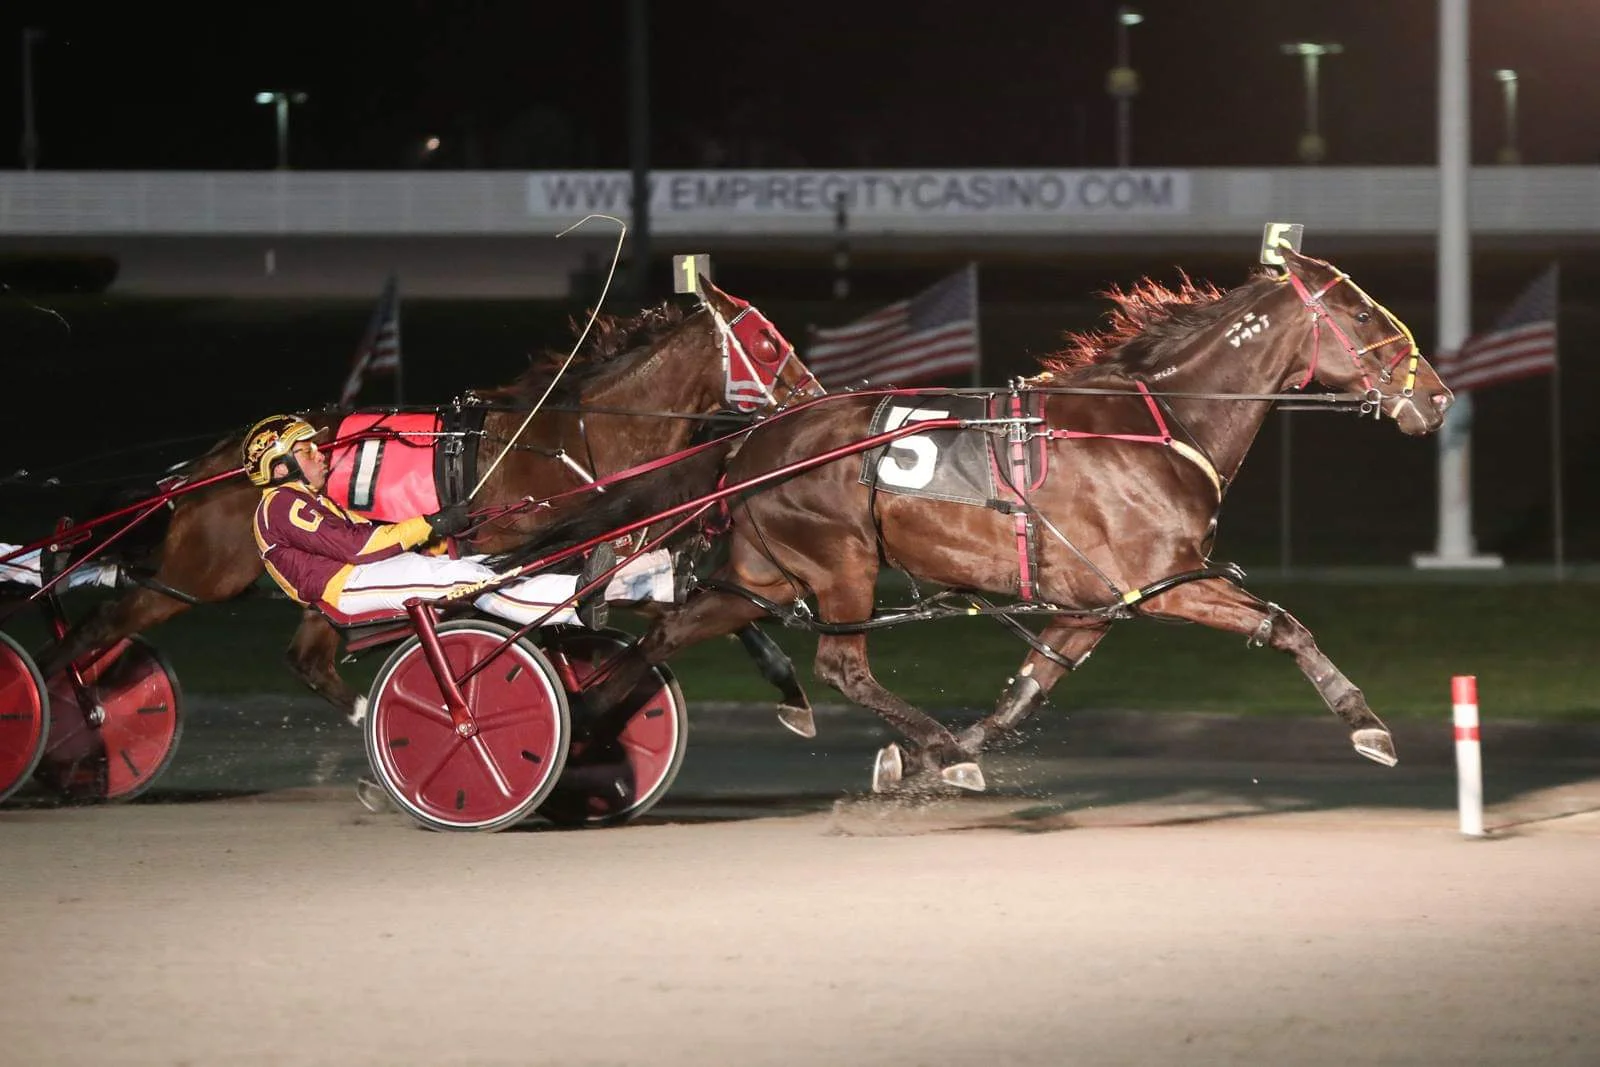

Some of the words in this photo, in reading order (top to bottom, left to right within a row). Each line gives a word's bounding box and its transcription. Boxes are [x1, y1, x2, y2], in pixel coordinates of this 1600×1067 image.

[1264, 223, 1292, 264] 5
[682, 255, 696, 292] 1
[877, 406, 949, 489] 5
